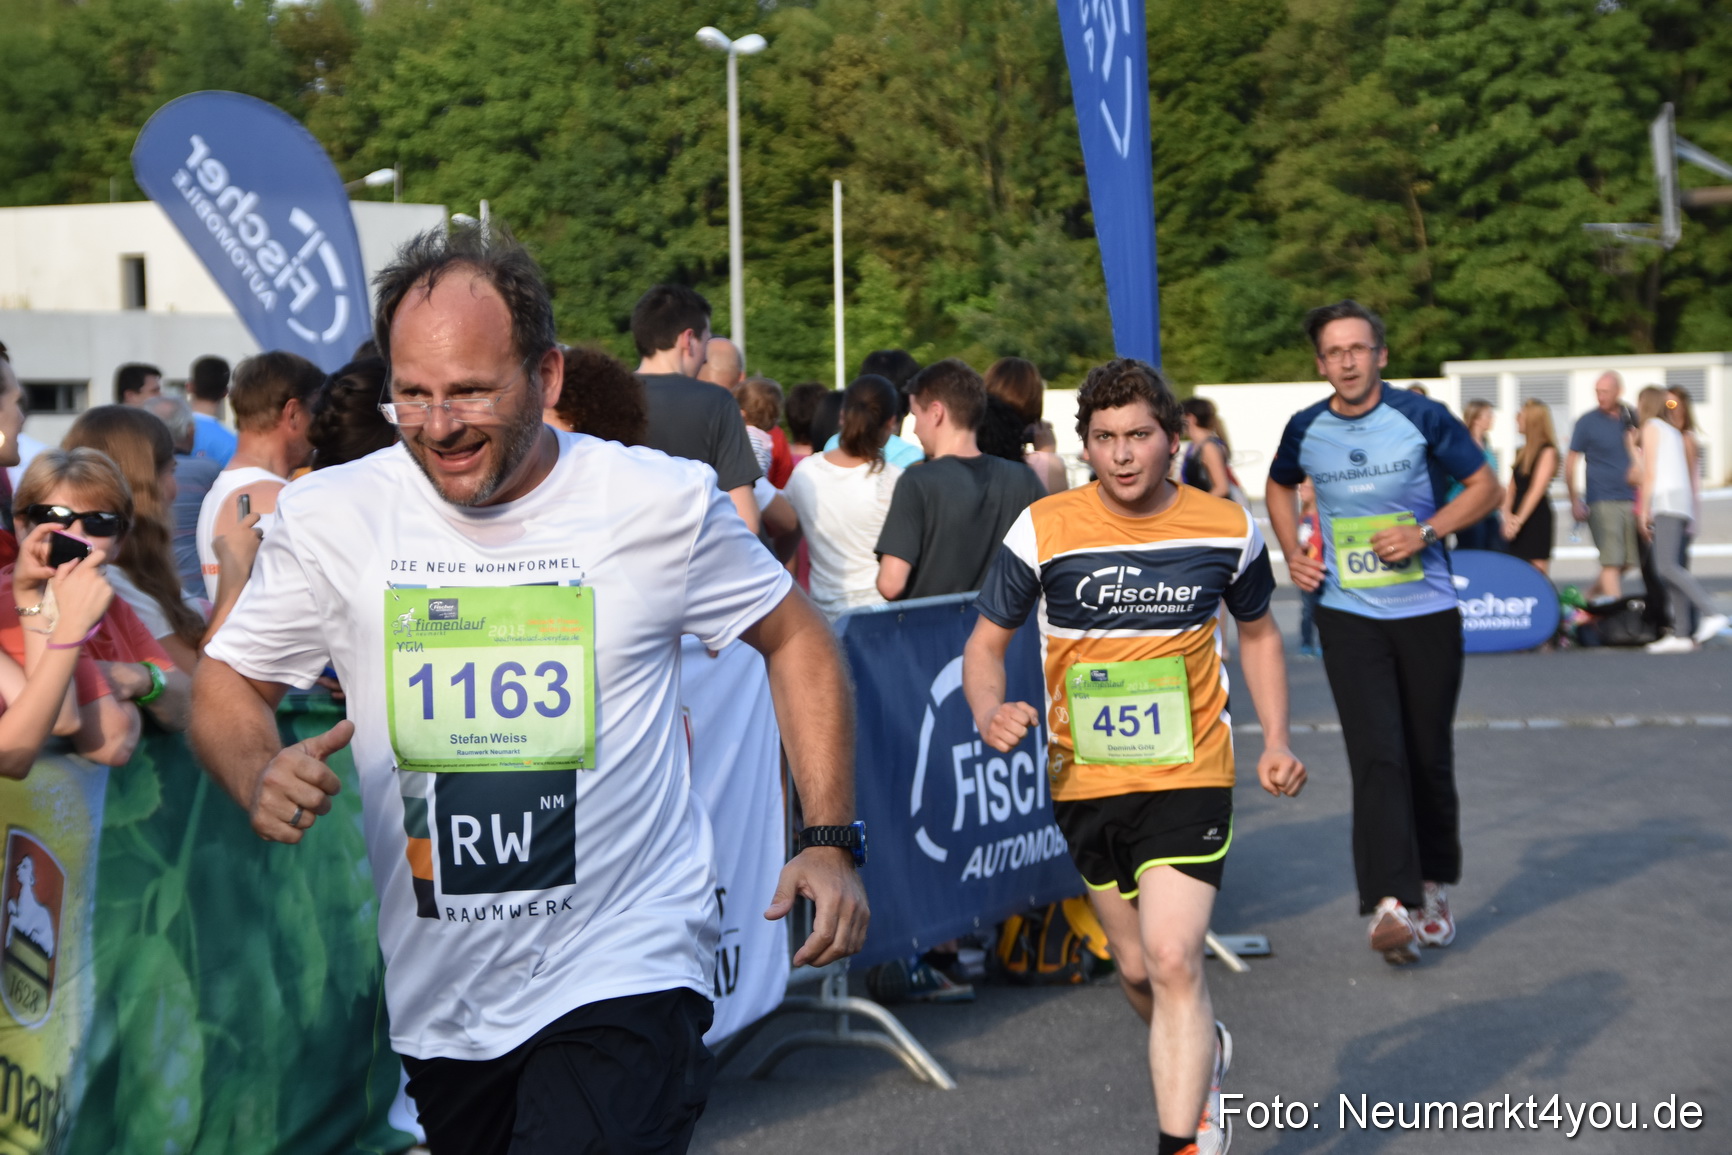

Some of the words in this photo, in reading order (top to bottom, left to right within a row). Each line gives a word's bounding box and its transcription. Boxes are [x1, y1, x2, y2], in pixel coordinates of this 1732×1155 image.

[390, 559, 418, 573] DIE
[426, 561, 466, 573] NEUE
[475, 557, 581, 573] WOHNFORMEL
[1098, 582, 1202, 604] Fischer
[1108, 604, 1195, 614] AUTOMOBILE
[415, 617, 487, 631] firmenlauf
[488, 625, 526, 638] 2015
[408, 660, 572, 720] 1163
[1093, 702, 1161, 737] 451
[449, 734, 488, 745] Stefan
[489, 733, 528, 744] Weiss
[540, 794, 565, 810] NM
[450, 811, 533, 866] RW
[446, 896, 573, 922] RAUMWERK
